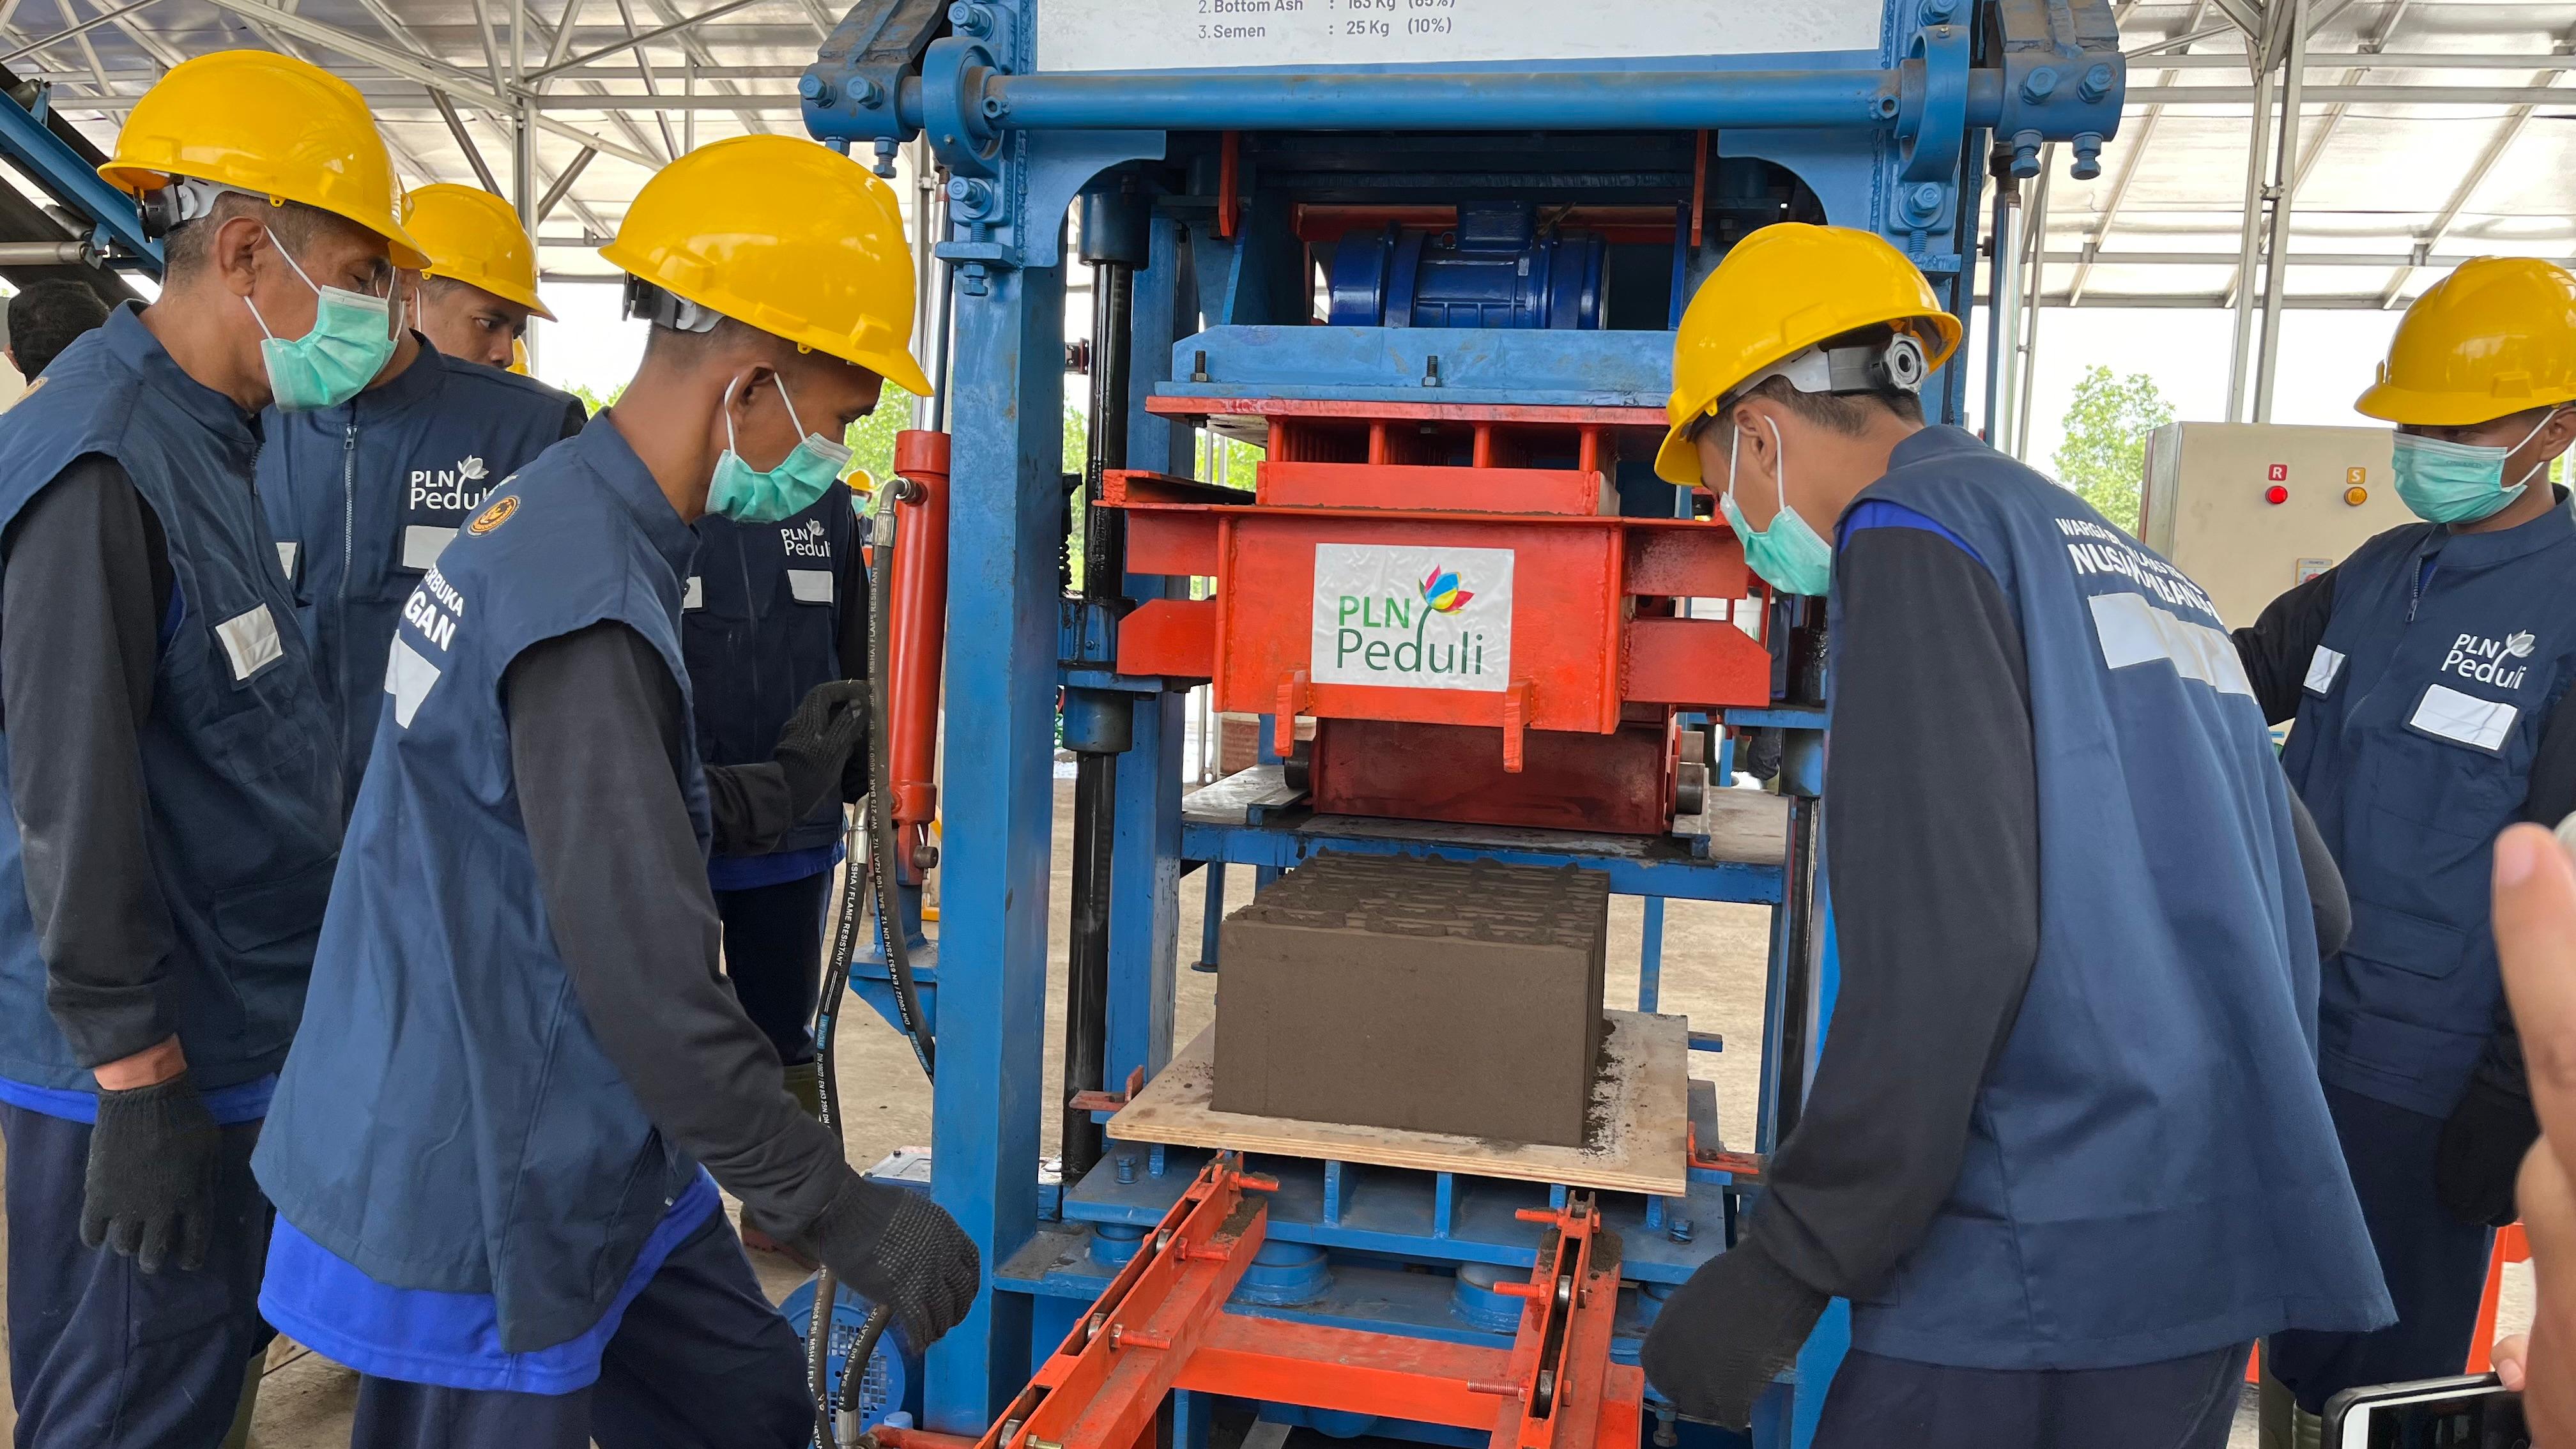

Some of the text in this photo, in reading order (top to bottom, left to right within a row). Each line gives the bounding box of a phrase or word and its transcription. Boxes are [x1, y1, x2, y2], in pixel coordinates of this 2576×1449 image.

[1215, 0, 1270, 13] Bottom
[1275, 0, 1303, 11] Ash
[1376, 0, 1396, 11] Kg
[1214, 24, 1266, 38] Semen
[1346, 20, 1365, 34] 25
[1369, 20, 1390, 37] Kg
[1407, 17, 1452, 34] (10%)
[411, 470, 454, 488] PLN
[2272, 466, 2283, 479] R
[2351, 470, 2361, 482] S
[780, 528, 809, 541] PLN
[2055, 518, 2110, 540] WARGA
[784, 540, 831, 558] Peduli
[870, 567, 878, 612] RESISTANT
[1338, 595, 1410, 629] PLN
[1337, 628, 1483, 675] Peduli
[2452, 633, 2501, 659] PLN
[2441, 649, 2527, 689] Peduli
[871, 816, 877, 829] WP
[844, 891, 855, 922] FLAME
[882, 916, 887, 925] 12
[884, 927, 890, 939] DN
[836, 923, 850, 967] RESISTANT
[885, 942, 894, 957] 2SN
[888, 960, 896, 974] 853
[891, 974, 899, 985] EN
[818, 1080, 825, 1089] EN
[820, 1100, 829, 1113] 2SN
[823, 1114, 831, 1124] DN
[848, 1348, 857, 1363] 100
[841, 1367, 851, 1386] SAE
[838, 1396, 845, 1406] 12
